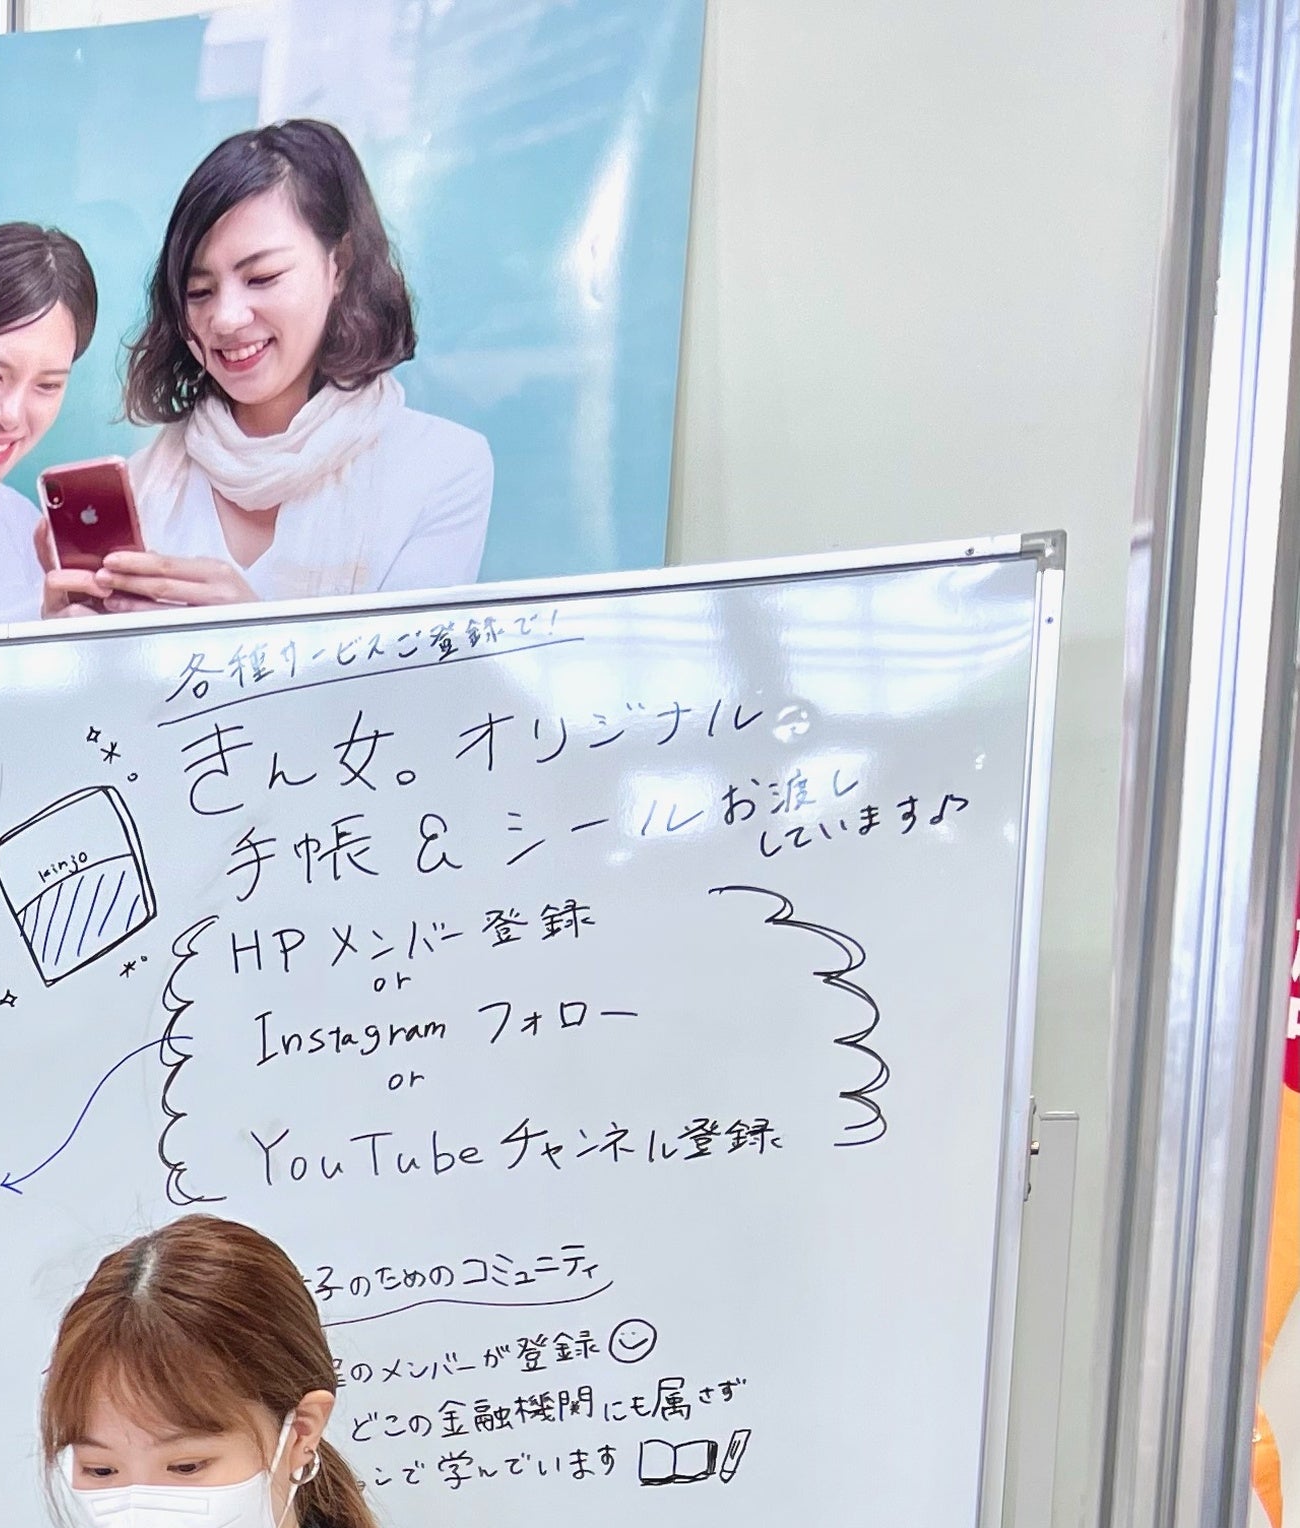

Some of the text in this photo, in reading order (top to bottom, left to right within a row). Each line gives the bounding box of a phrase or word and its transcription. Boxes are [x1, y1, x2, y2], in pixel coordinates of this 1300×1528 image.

[37, 851, 88, 884] kinjo
[372, 973, 412, 995] or
[256, 1000, 639, 1070] Instagram フォロー
[387, 1068, 427, 1094] or
[250, 1127, 483, 1190] YouTube
[303, 1244, 600, 1302] 子のためのコミュニティ
